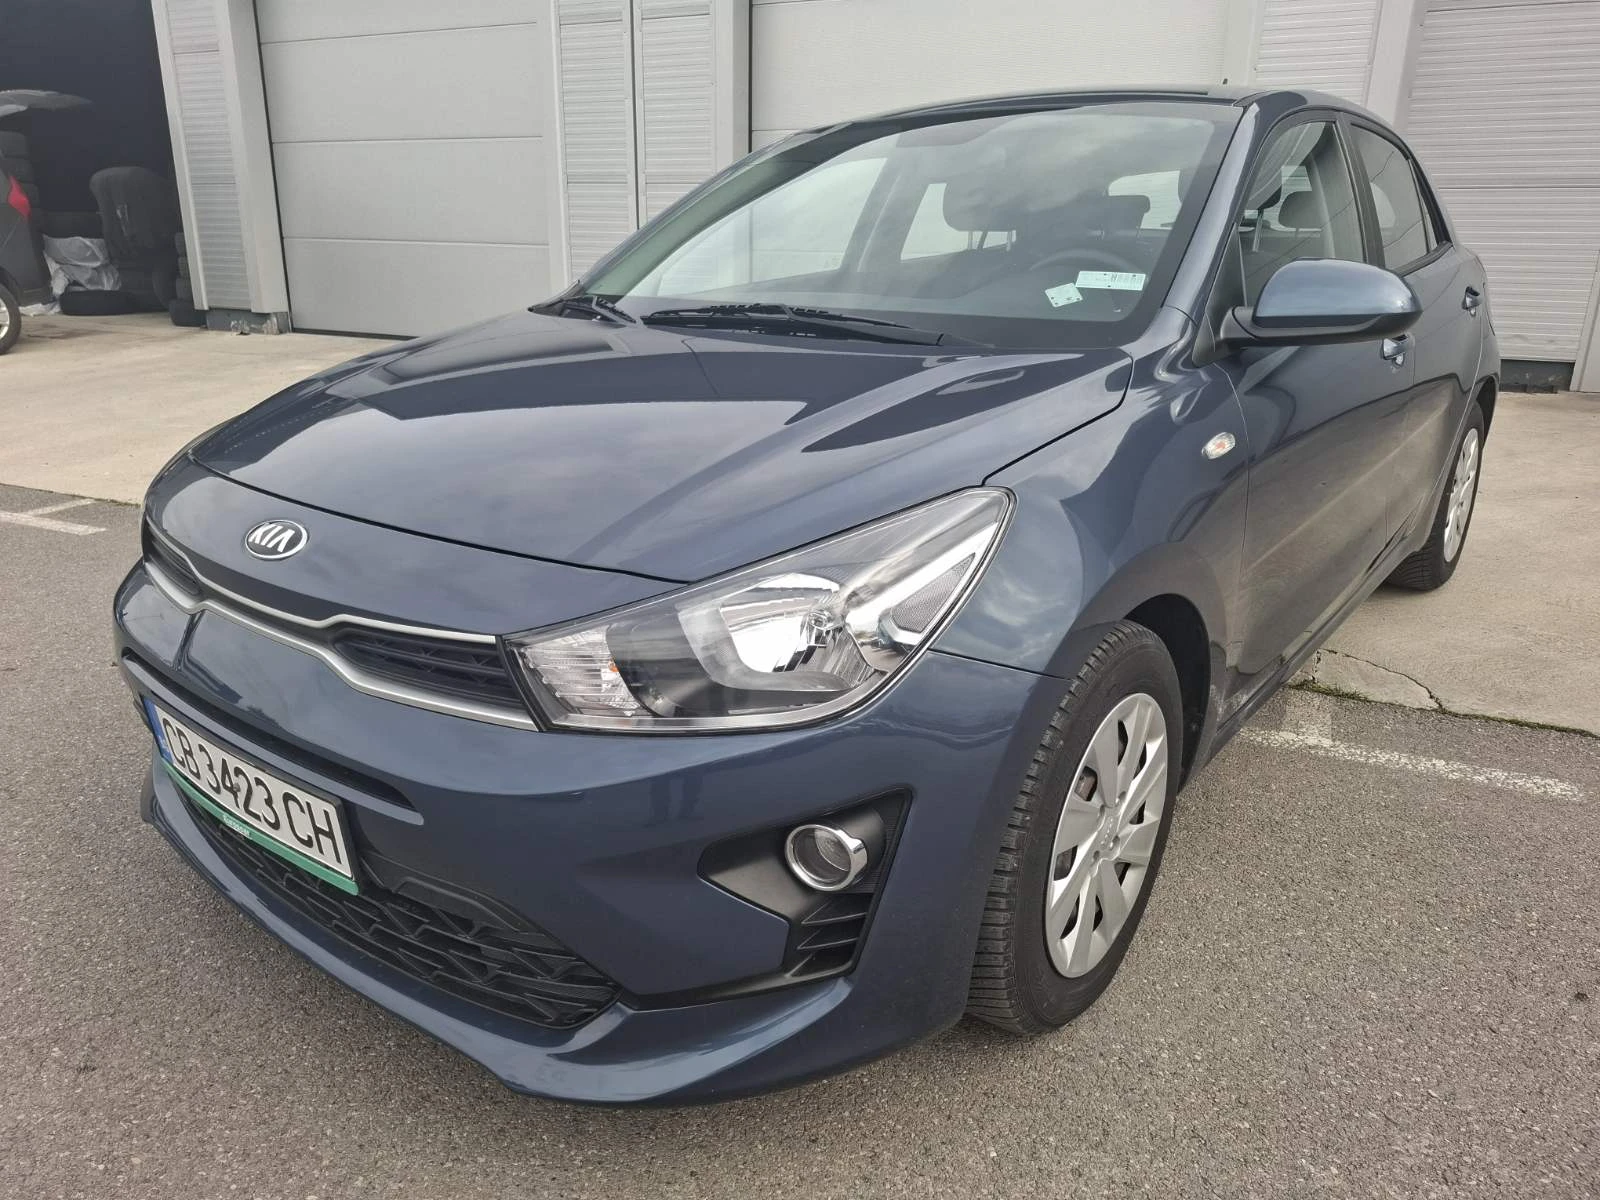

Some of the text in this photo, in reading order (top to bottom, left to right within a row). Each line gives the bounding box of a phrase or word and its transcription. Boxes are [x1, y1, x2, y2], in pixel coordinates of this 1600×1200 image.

[248, 523, 295, 553] KIA
[163, 718, 343, 865] CB 3423 CH
